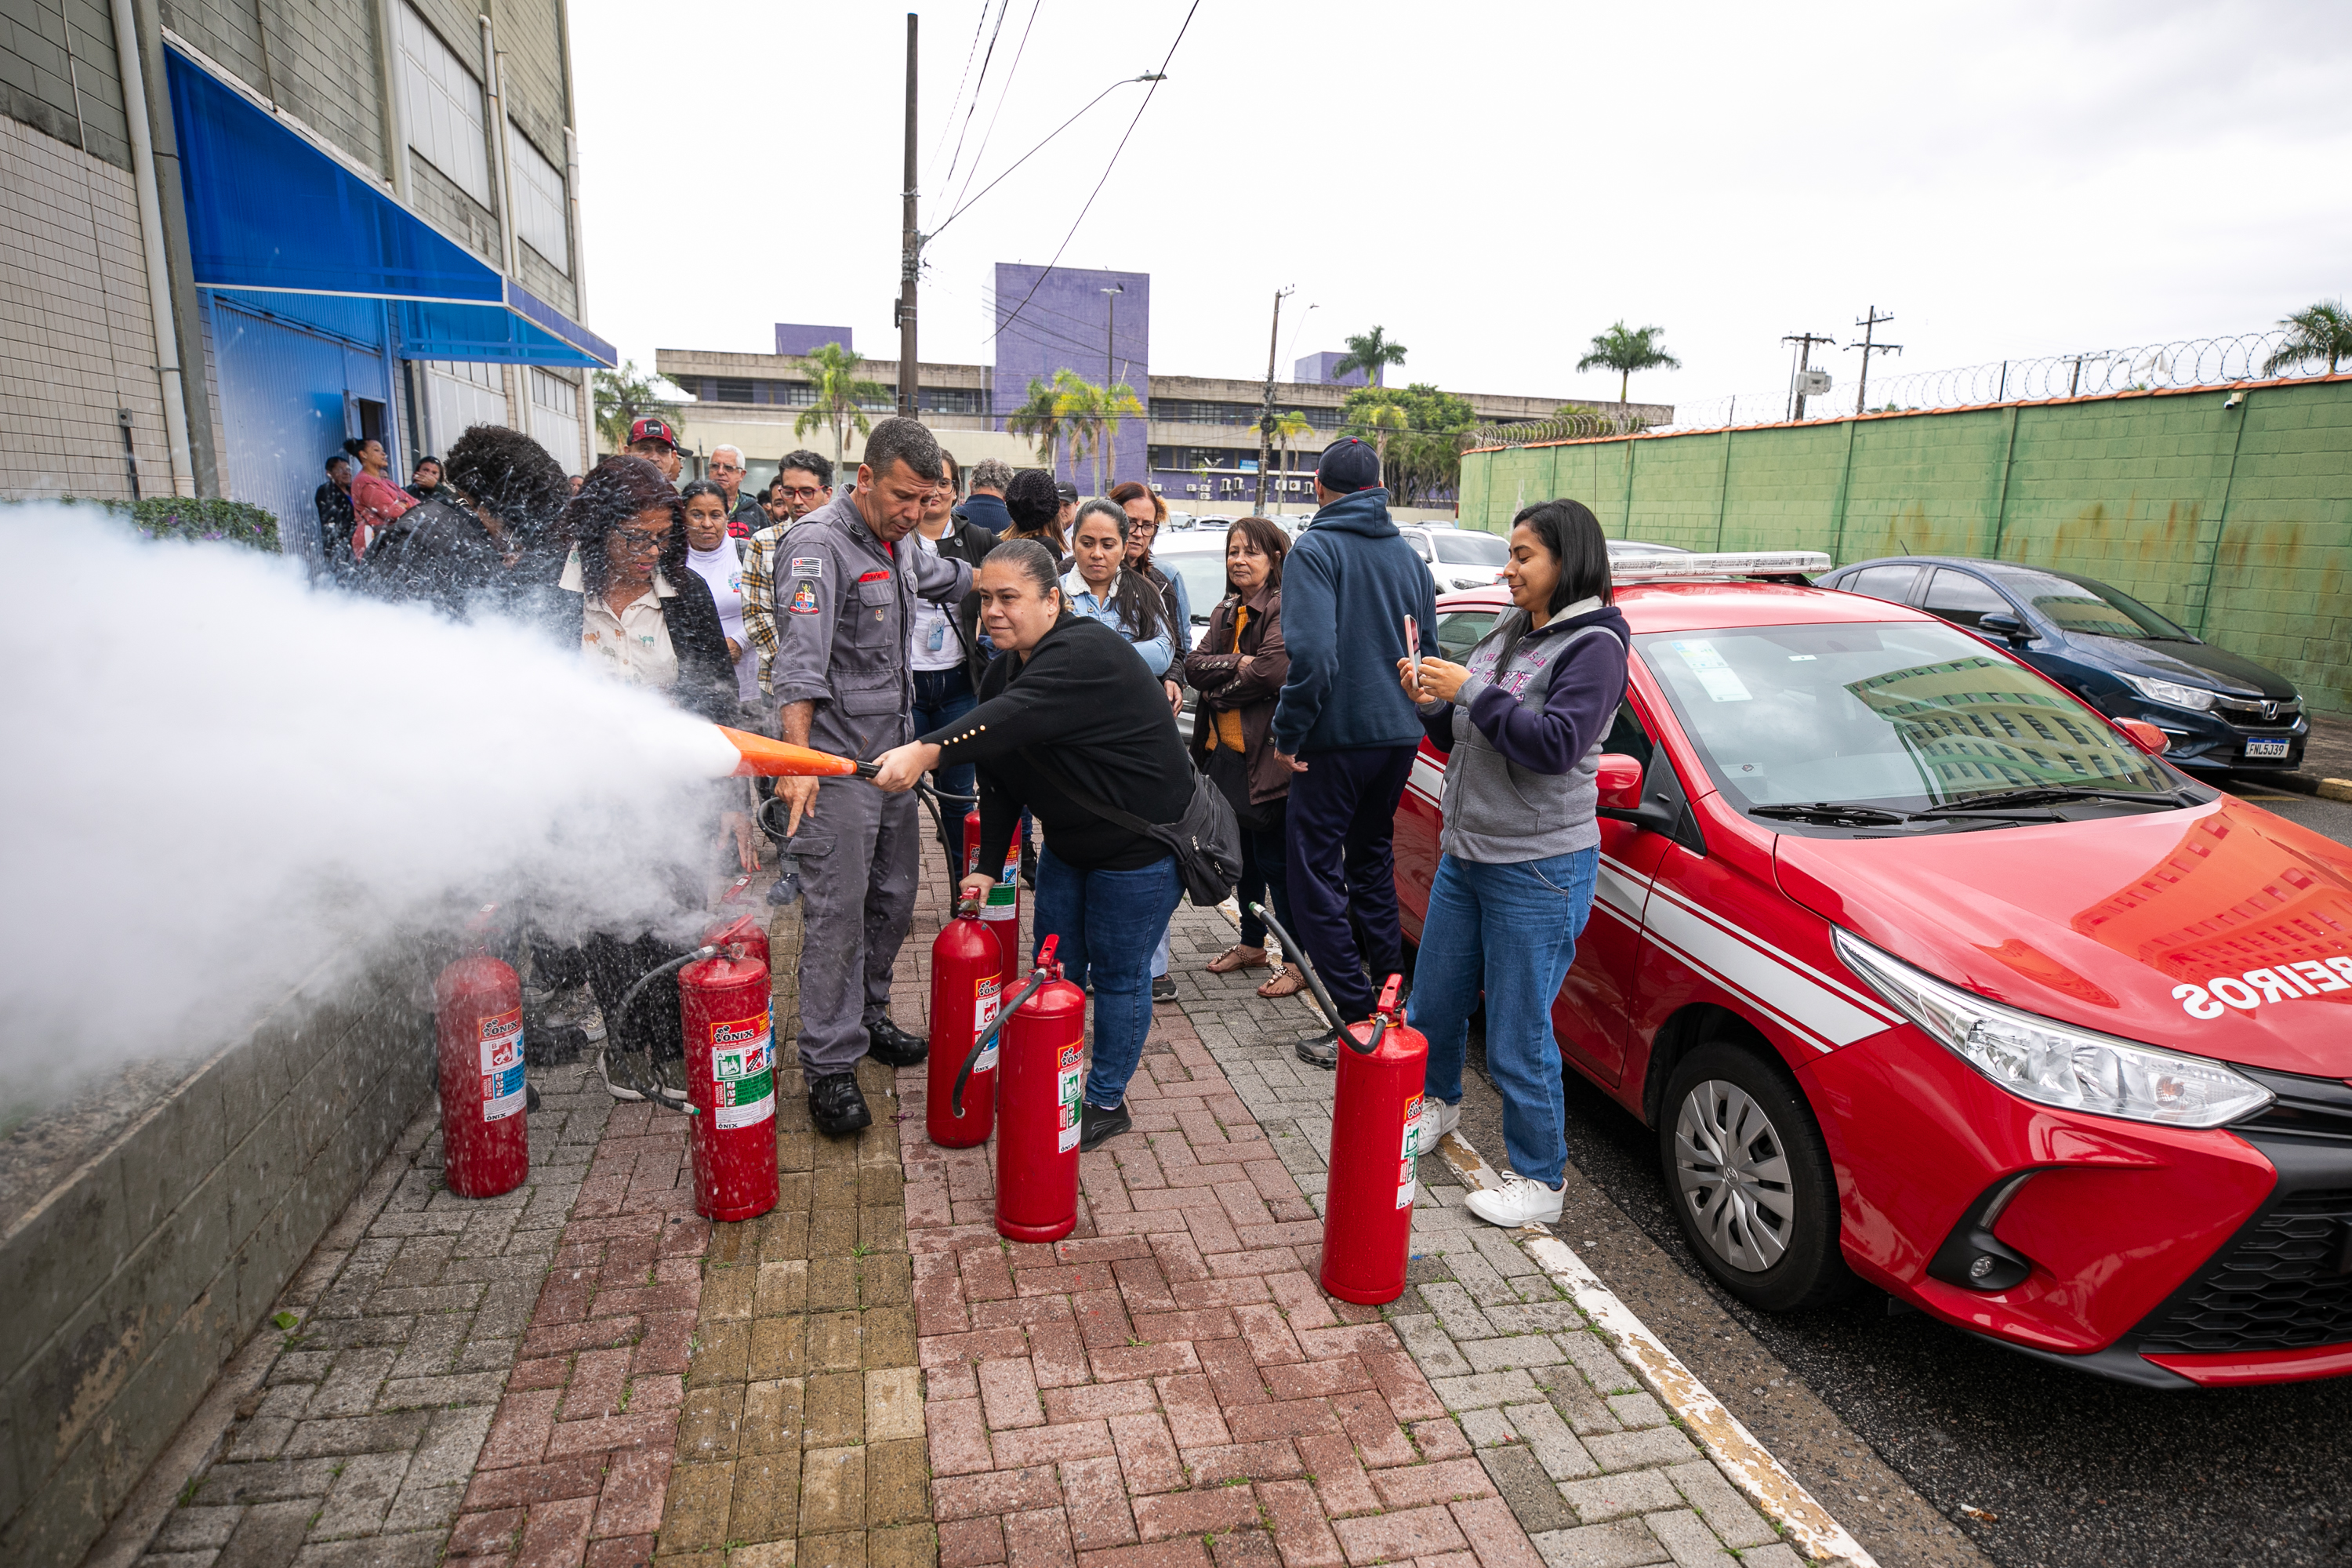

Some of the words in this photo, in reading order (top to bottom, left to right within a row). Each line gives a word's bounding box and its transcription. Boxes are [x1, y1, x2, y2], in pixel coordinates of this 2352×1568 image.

[2249, 743, 2285, 756] FNL5J39
[491, 1020, 518, 1035] ÔNIX
[723, 1029, 753, 1041] ÔNIX
[486, 1112, 506, 1121] ÔNIX
[1061, 1142, 1075, 1152] ÔNIX
